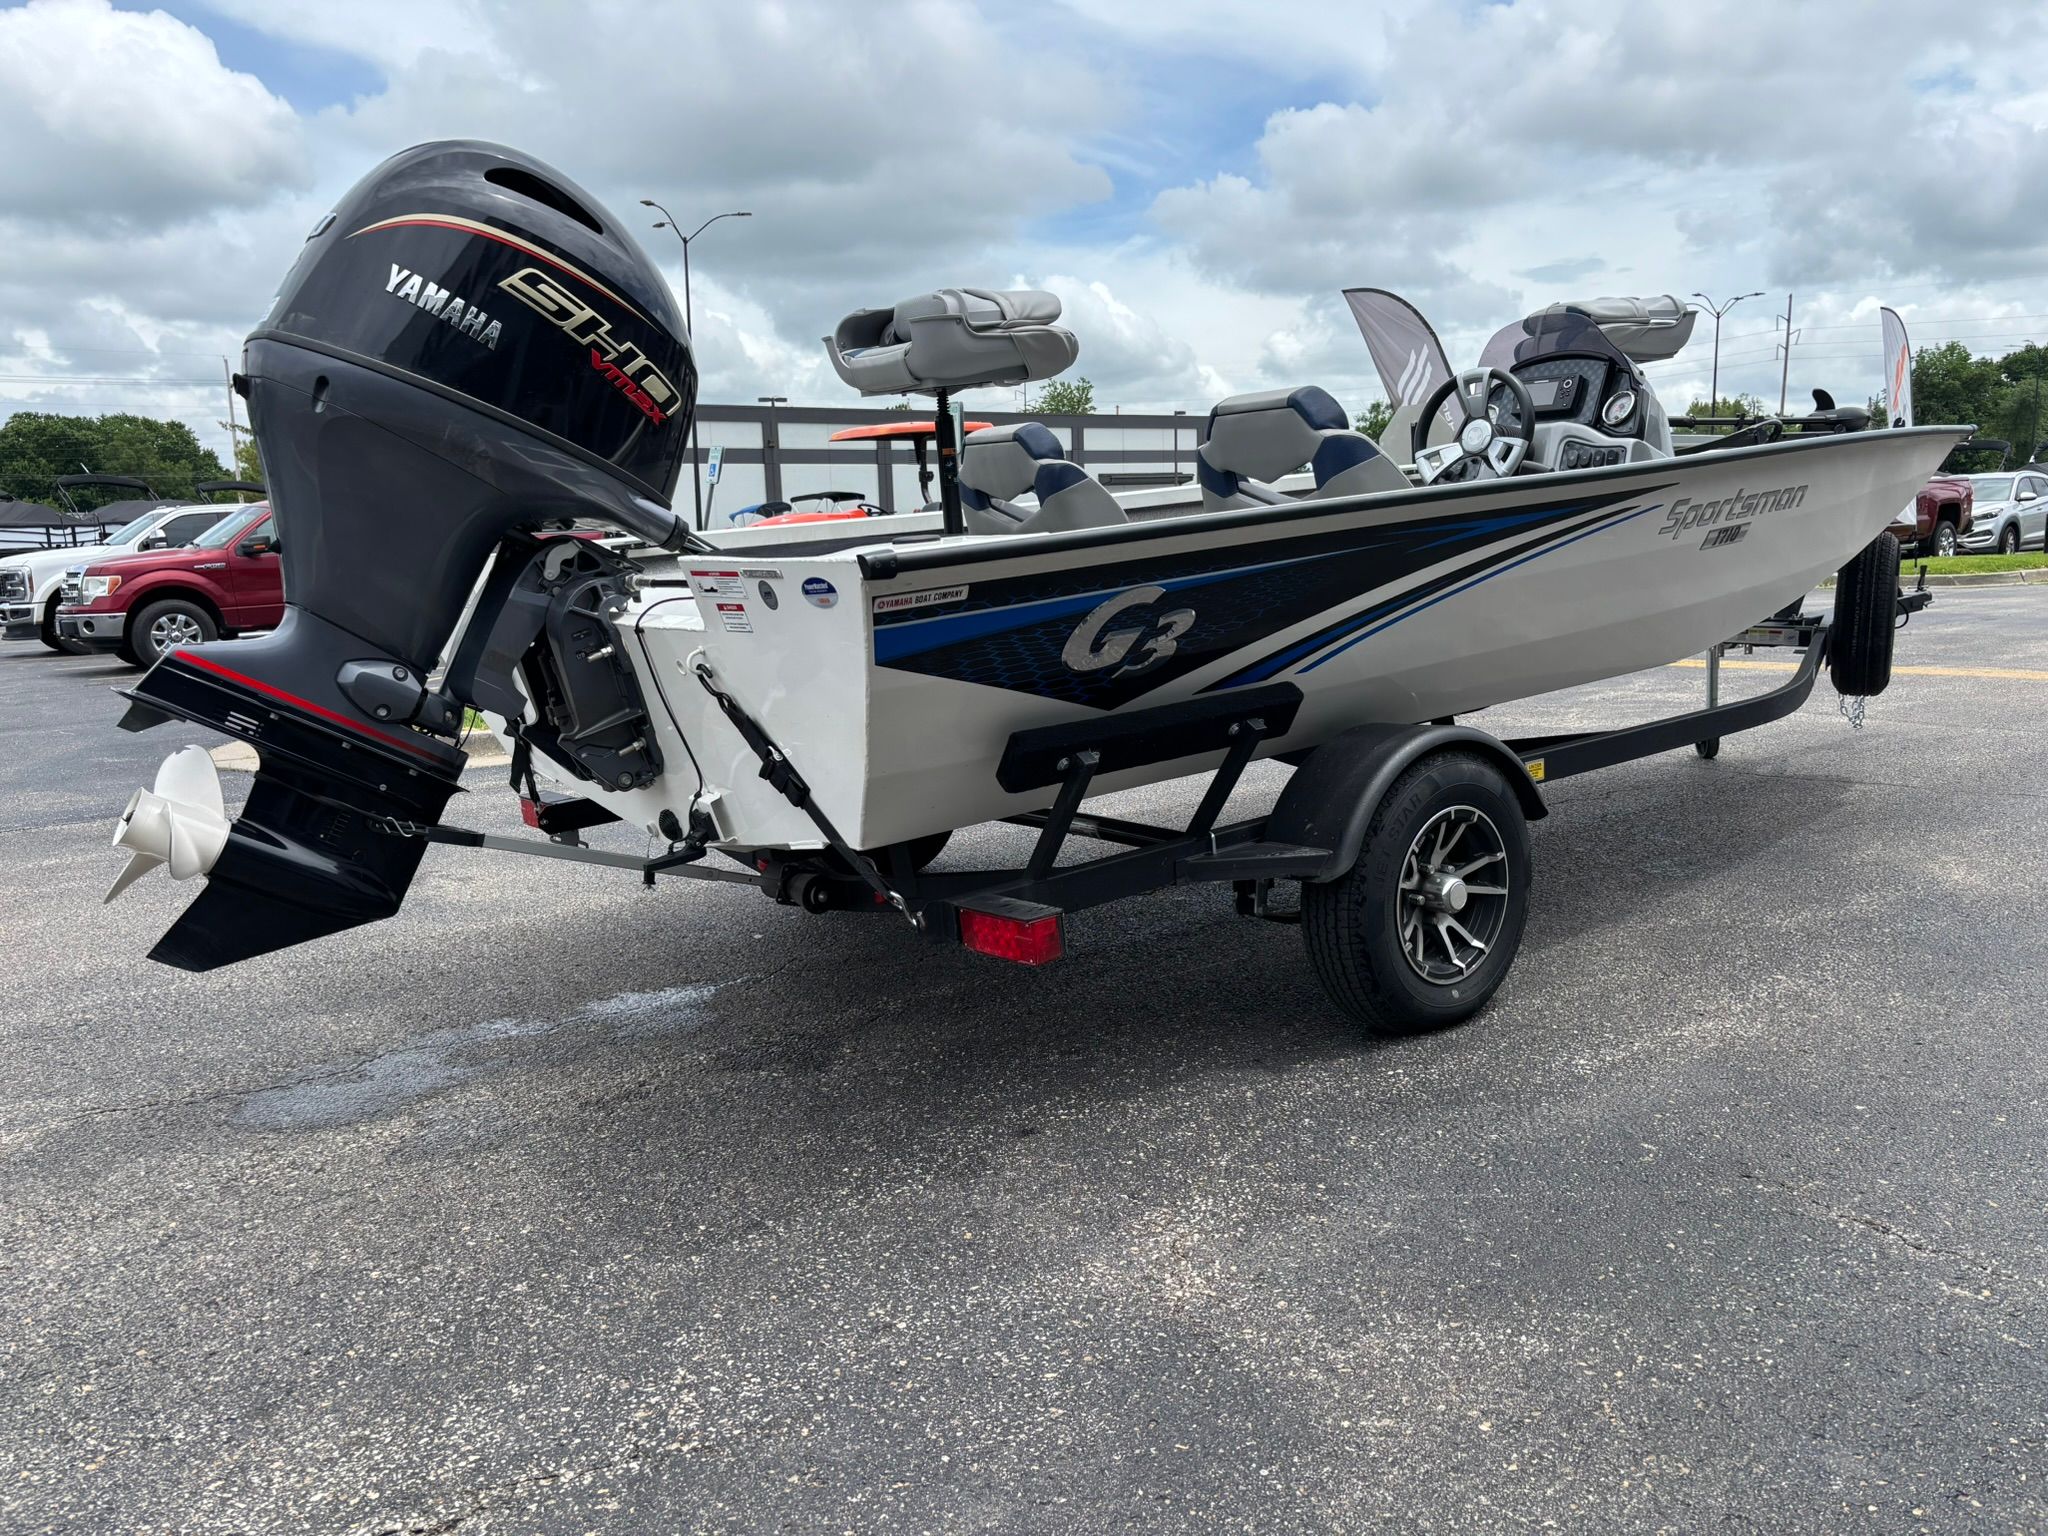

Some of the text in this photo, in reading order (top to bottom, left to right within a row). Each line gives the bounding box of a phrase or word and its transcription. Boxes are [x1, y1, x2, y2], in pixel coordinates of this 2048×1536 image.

[384, 263, 503, 351] YAMAHA
[497, 267, 682, 417] SHO
[1658, 484, 1809, 540] Sportsman
[1712, 525, 1742, 546] 1710
[883, 589, 964, 609] YAMAHA BOAT COMPANY
[1061, 585, 1197, 679] G3
